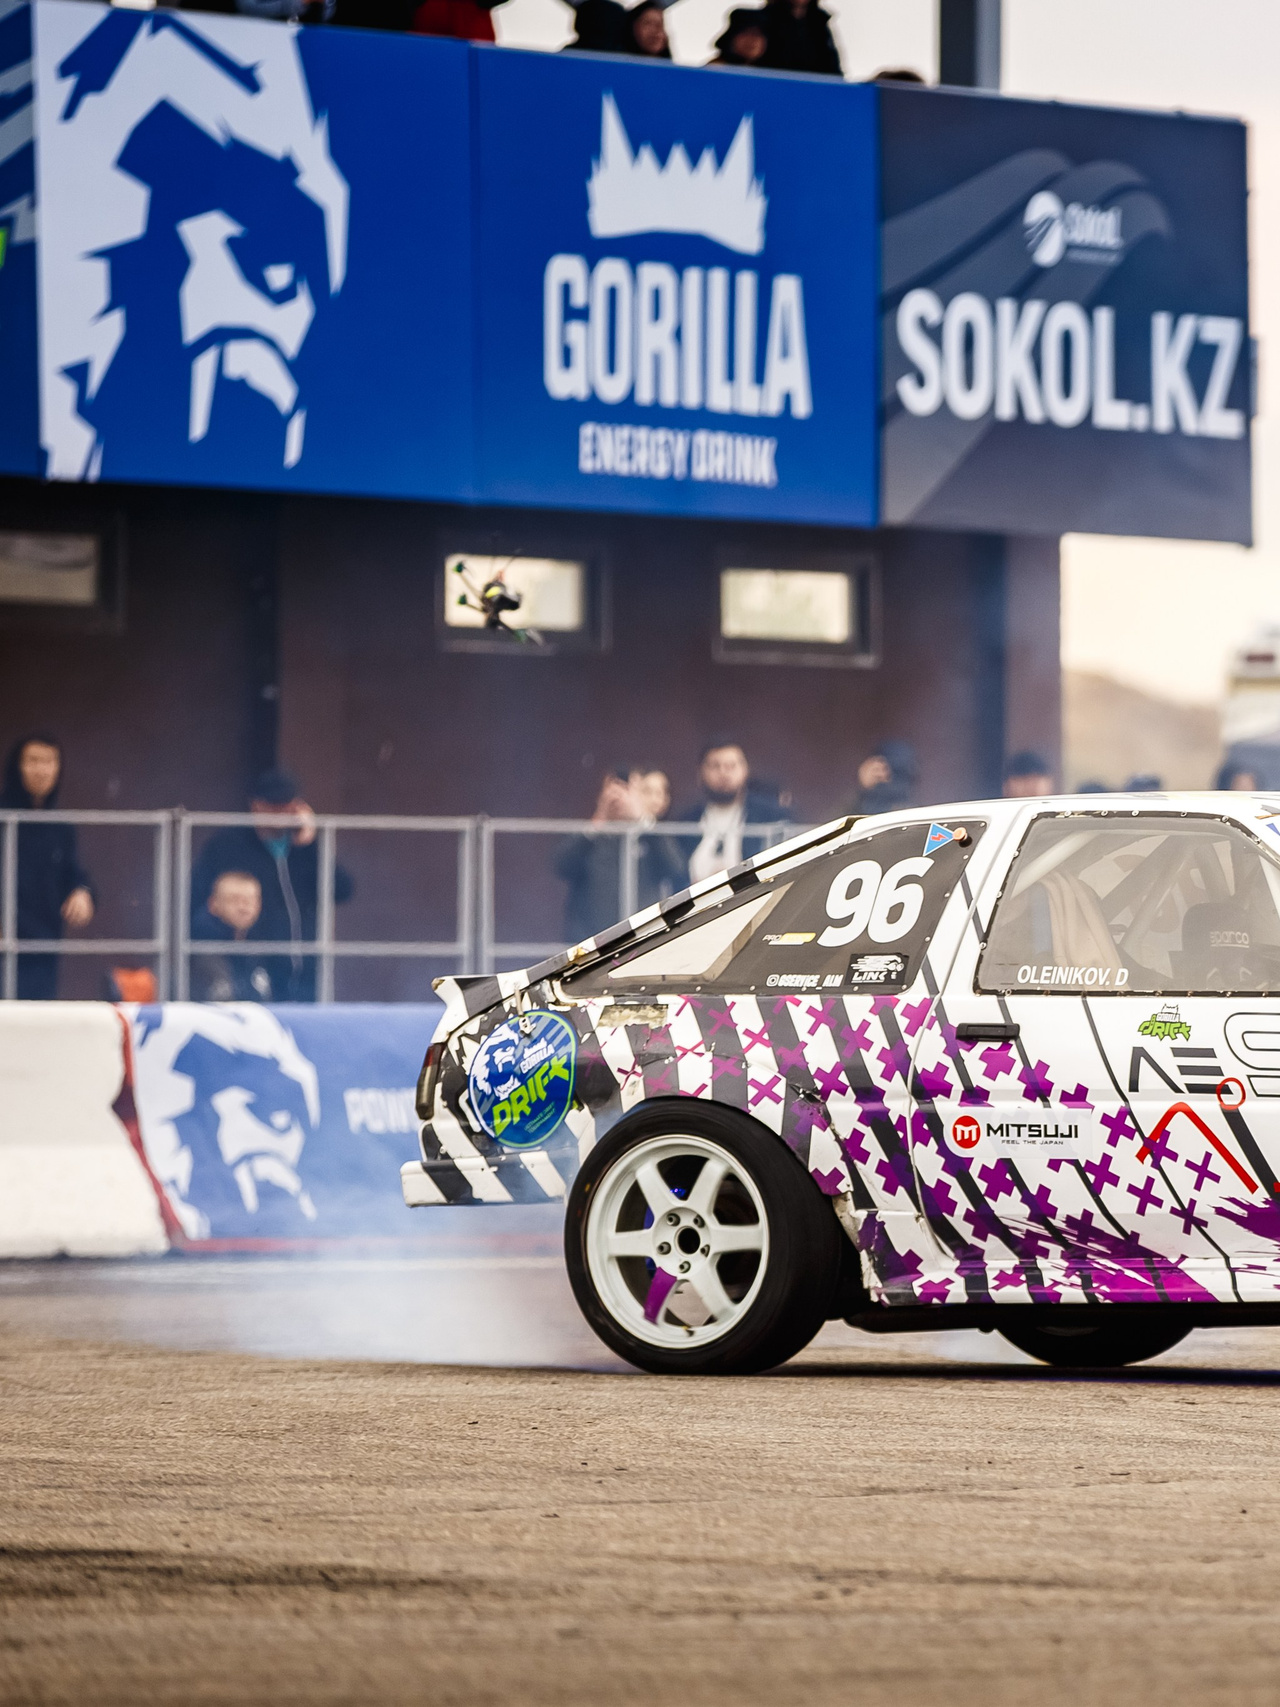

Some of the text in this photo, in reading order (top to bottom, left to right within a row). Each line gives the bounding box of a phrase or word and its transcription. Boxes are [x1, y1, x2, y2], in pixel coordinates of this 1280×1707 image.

[543, 253, 813, 420] GORILLA
[896, 287, 1245, 439] SOKOL.KZ
[578, 421, 778, 489] ENERGY DRINK
[816, 856, 935, 947] 96
[1017, 965, 1129, 986] OLEINIKOV. D
[519, 1043, 556, 1074] GORILLA
[986, 1123, 1078, 1138] MITSUJI
